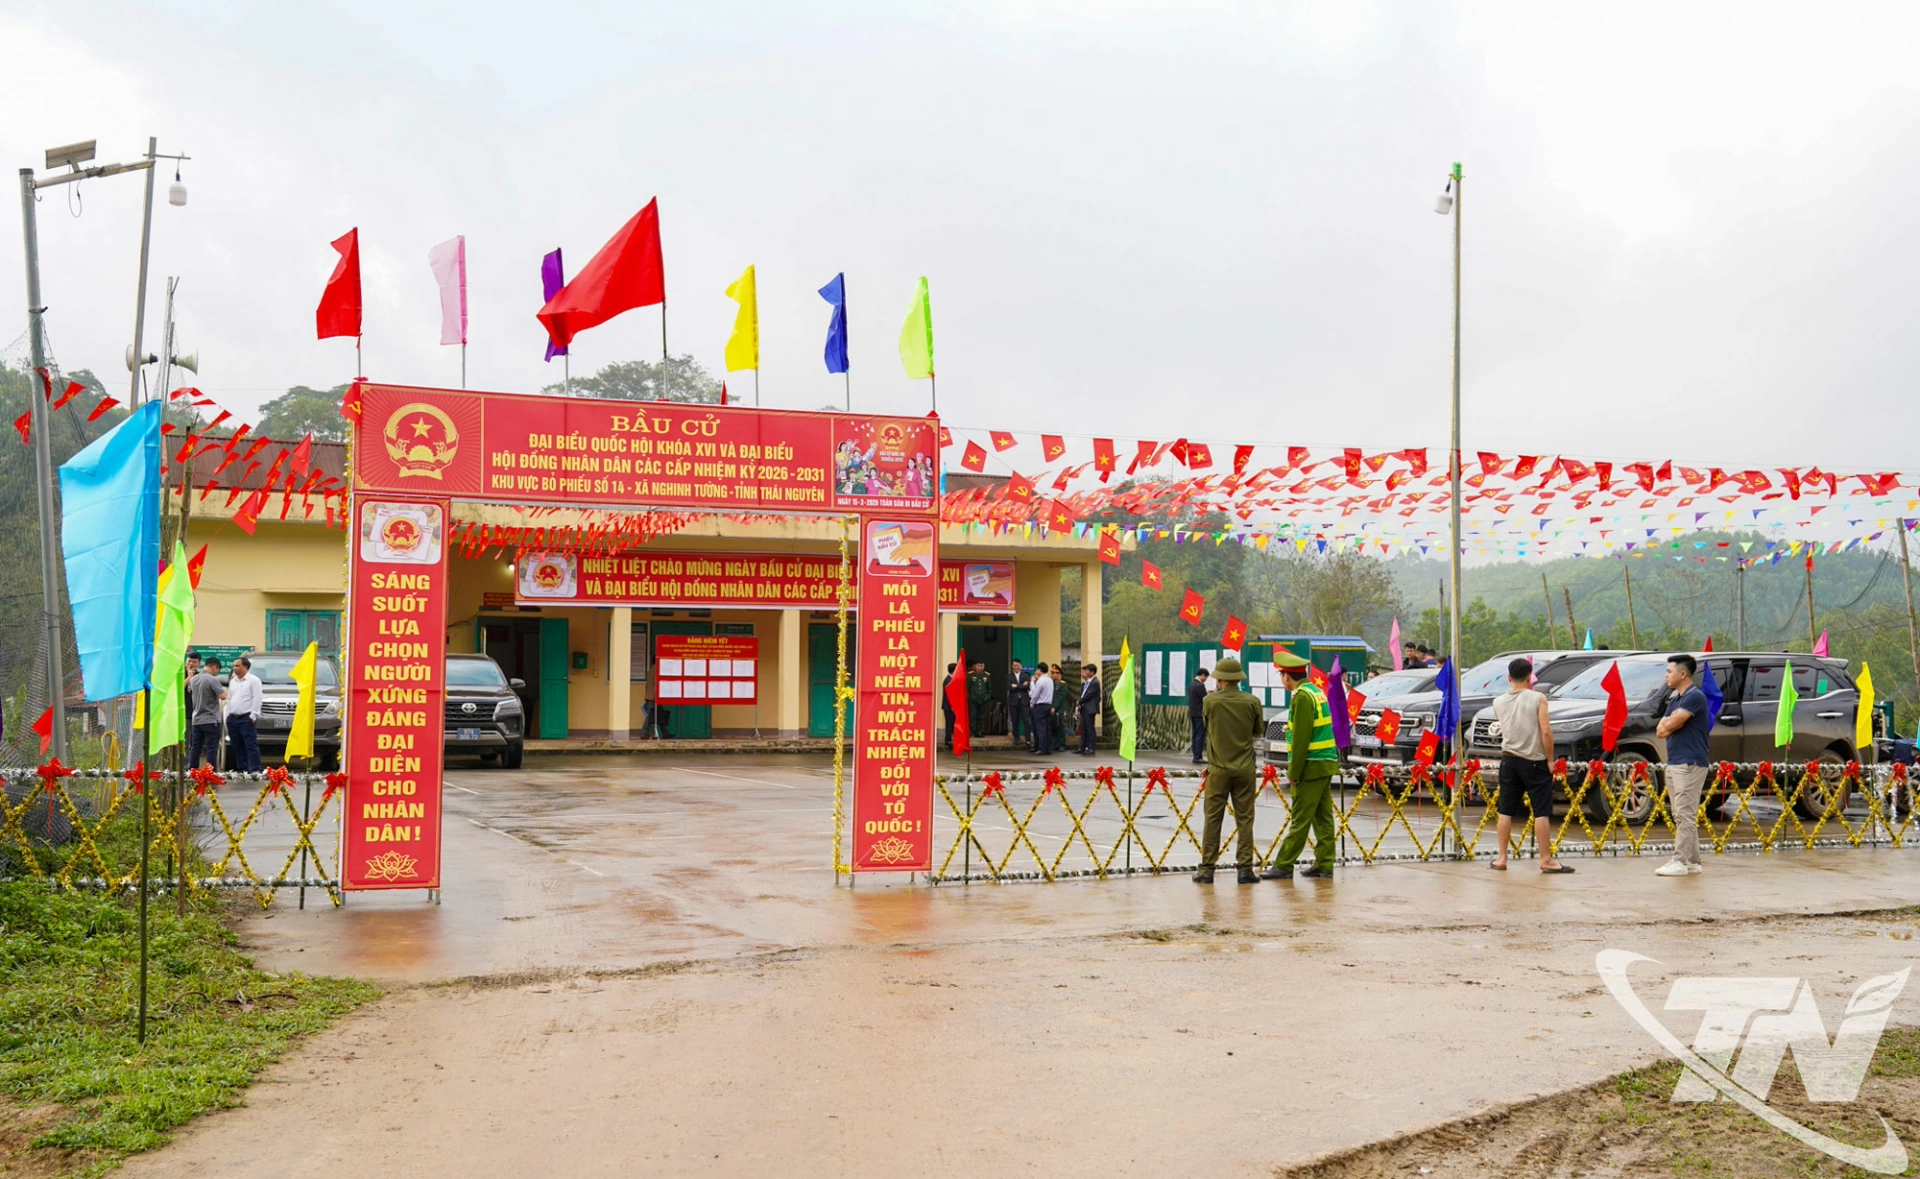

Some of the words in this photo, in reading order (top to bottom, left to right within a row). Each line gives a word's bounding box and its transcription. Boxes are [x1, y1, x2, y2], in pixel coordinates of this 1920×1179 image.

[611, 408, 672, 434] BẦU
[681, 413, 720, 437] CỬ
[529, 433, 552, 452] ĐẠI
[556, 430, 587, 451] BIỂU
[591, 433, 627, 453] QUỐC
[631, 436, 653, 456] HỘI
[657, 439, 692, 456] KHÓA
[696, 443, 716, 457] XVI
[720, 441, 736, 458] VÀ
[740, 445, 761, 462] ĐẠI
[765, 441, 793, 461] BIỂU
[492, 450, 515, 470] HỘI
[520, 449, 558, 470] ĐỒNG
[562, 455, 599, 472] NHÂN
[604, 456, 631, 473] DÂN
[635, 457, 662, 475] CÁC
[666, 457, 692, 476] CẤP
[694, 461, 736, 481] NHIỆM
[740, 460, 756, 479] KỲ
[758, 466, 788, 480] 2026
[797, 468, 825, 482] 2031
[492, 474, 514, 490] KHU
[517, 476, 539, 493] VỰC
[541, 473, 556, 492] BỎ
[559, 474, 592, 493] PHIẾU
[594, 474, 609, 493] SỐ
[611, 481, 625, 494] 14
[635, 479, 649, 495] XÃ
[652, 482, 691, 497] NGHINH
[694, 480, 728, 498] TƯỜNG
[735, 481, 757, 500] TỈNH
[760, 484, 782, 500] THÁI
[785, 486, 825, 502] NGUYÊN
[583, 557, 619, 577] NHIỆT
[622, 557, 647, 578] LIỆT
[650, 558, 683, 576] CHÀO
[686, 558, 722, 577] MỪNG
[725, 559, 757, 577] NGÀY
[760, 558, 783, 577] BẦU
[786, 557, 803, 578] CỬ
[805, 564, 824, 581] ĐẠI
[942, 568, 960, 582] XVI
[371, 570, 431, 590] SÁNG
[585, 577, 601, 595] VÀ
[605, 580, 626, 599] ĐẠI
[629, 575, 657, 596] BIỂU
[661, 578, 681, 599] HỘI
[684, 577, 717, 598] ĐỒNG
[720, 580, 753, 598] NHÂN
[757, 581, 781, 598] DÂN
[784, 582, 807, 599] CÁC
[810, 580, 833, 599] CẤP
[882, 579, 917, 596] MỖI
[372, 592, 428, 613] SUỐT
[889, 599, 910, 614] LÁ
[379, 618, 420, 638] LỰA
[873, 616, 925, 633] PHIẾU
[368, 641, 428, 661] CHỌN
[888, 635, 910, 650] LÀ
[879, 653, 918, 671] MỘT
[364, 662, 431, 681] NGƯỜI
[874, 672, 921, 688] NIỀM
[367, 684, 427, 704] XỨNG
[880, 692, 914, 706] TIN,
[366, 708, 426, 727] ĐÁNG
[878, 708, 916, 726] MỘT
[377, 734, 414, 752] ĐẠI
[868, 727, 925, 742] TRÁCH
[866, 744, 925, 761] NHIỆM
[369, 754, 421, 776] DIỆN
[880, 762, 910, 779] ĐỐI
[372, 780, 416, 796] CHO
[880, 780, 909, 796] VỚI
[363, 800, 424, 819] NHÂN
[884, 798, 906, 815] TỔ
